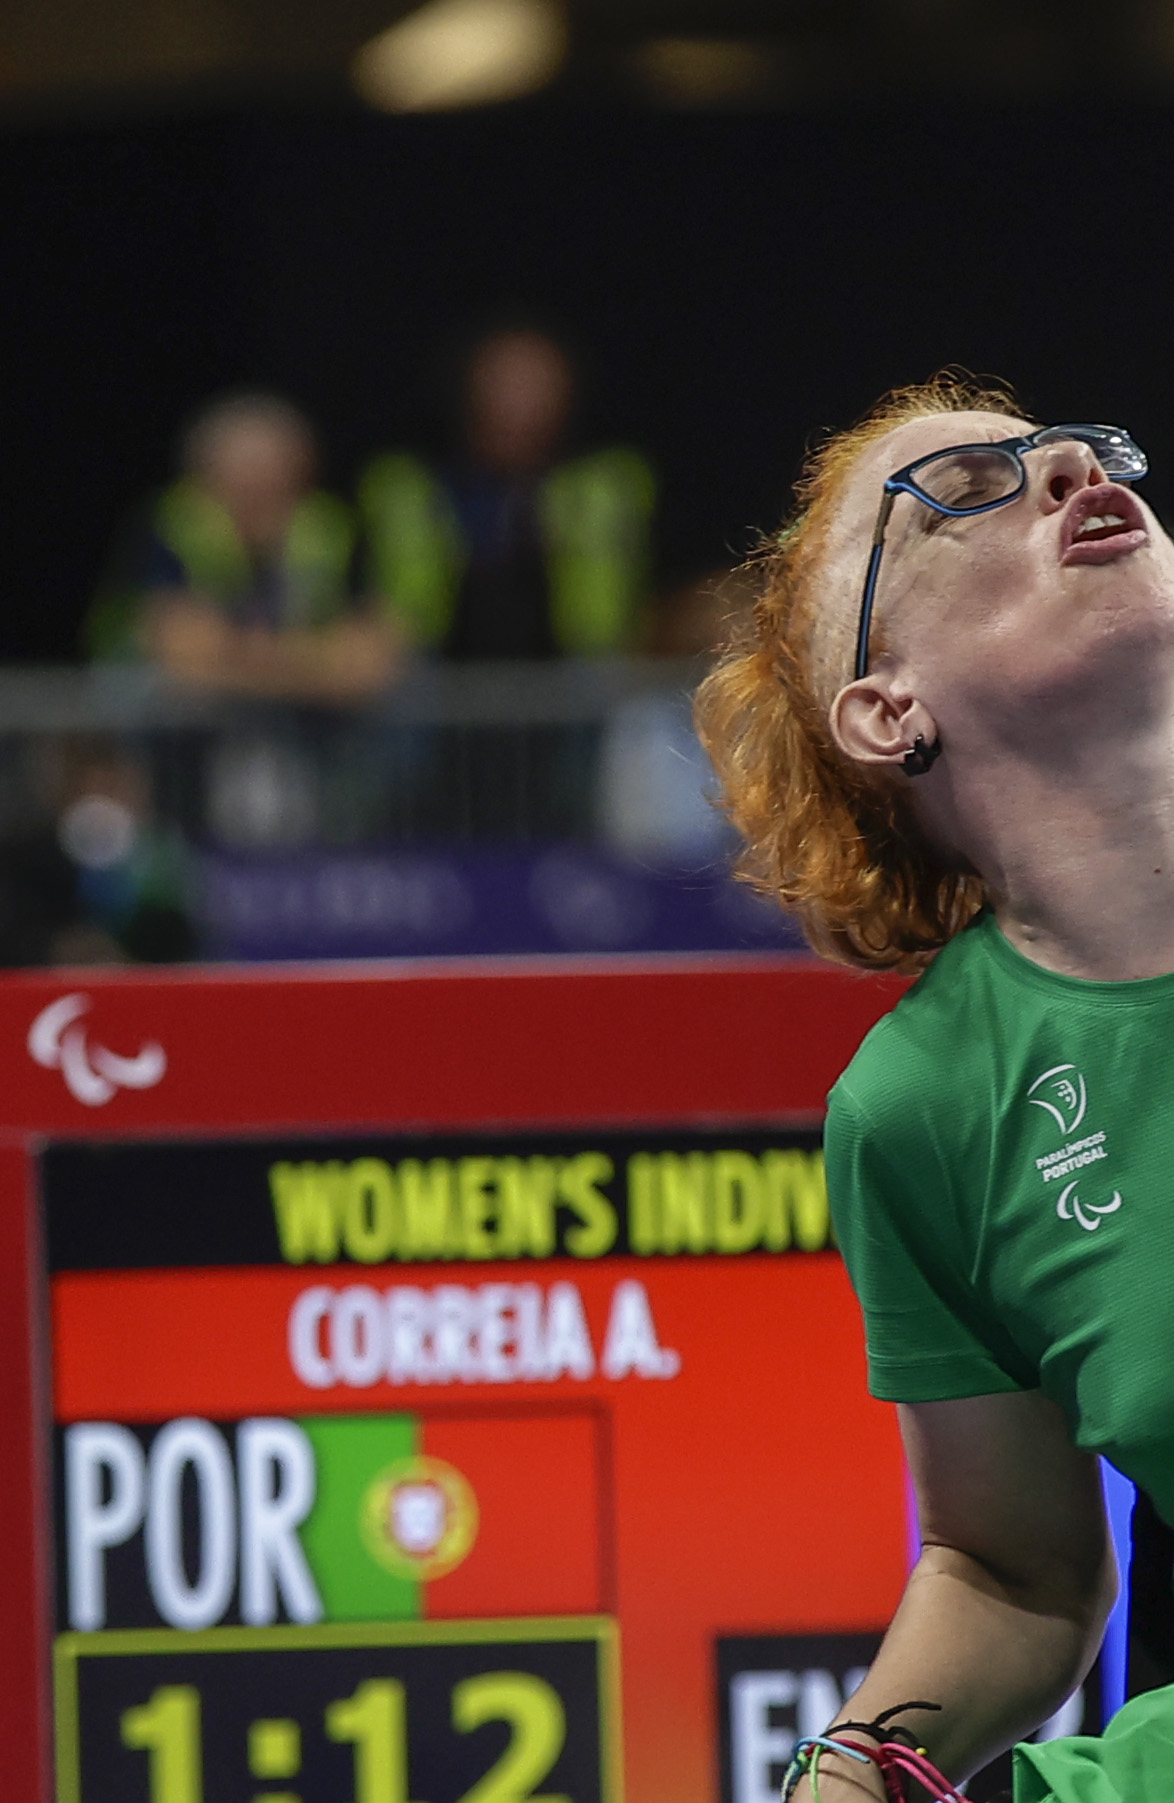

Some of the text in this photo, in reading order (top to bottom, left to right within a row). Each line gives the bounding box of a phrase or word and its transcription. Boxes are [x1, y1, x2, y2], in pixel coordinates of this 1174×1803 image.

[1036, 1130, 1107, 1170] PARALÍMPICOS
[1042, 1145, 1108, 1183] PORTUGAL
[270, 1152, 617, 1264] WOMEN'S
[288, 1279, 681, 1388] CORREIA A.
[64, 1415, 324, 1632] POR
[118, 1671, 567, 1803] 1:12
